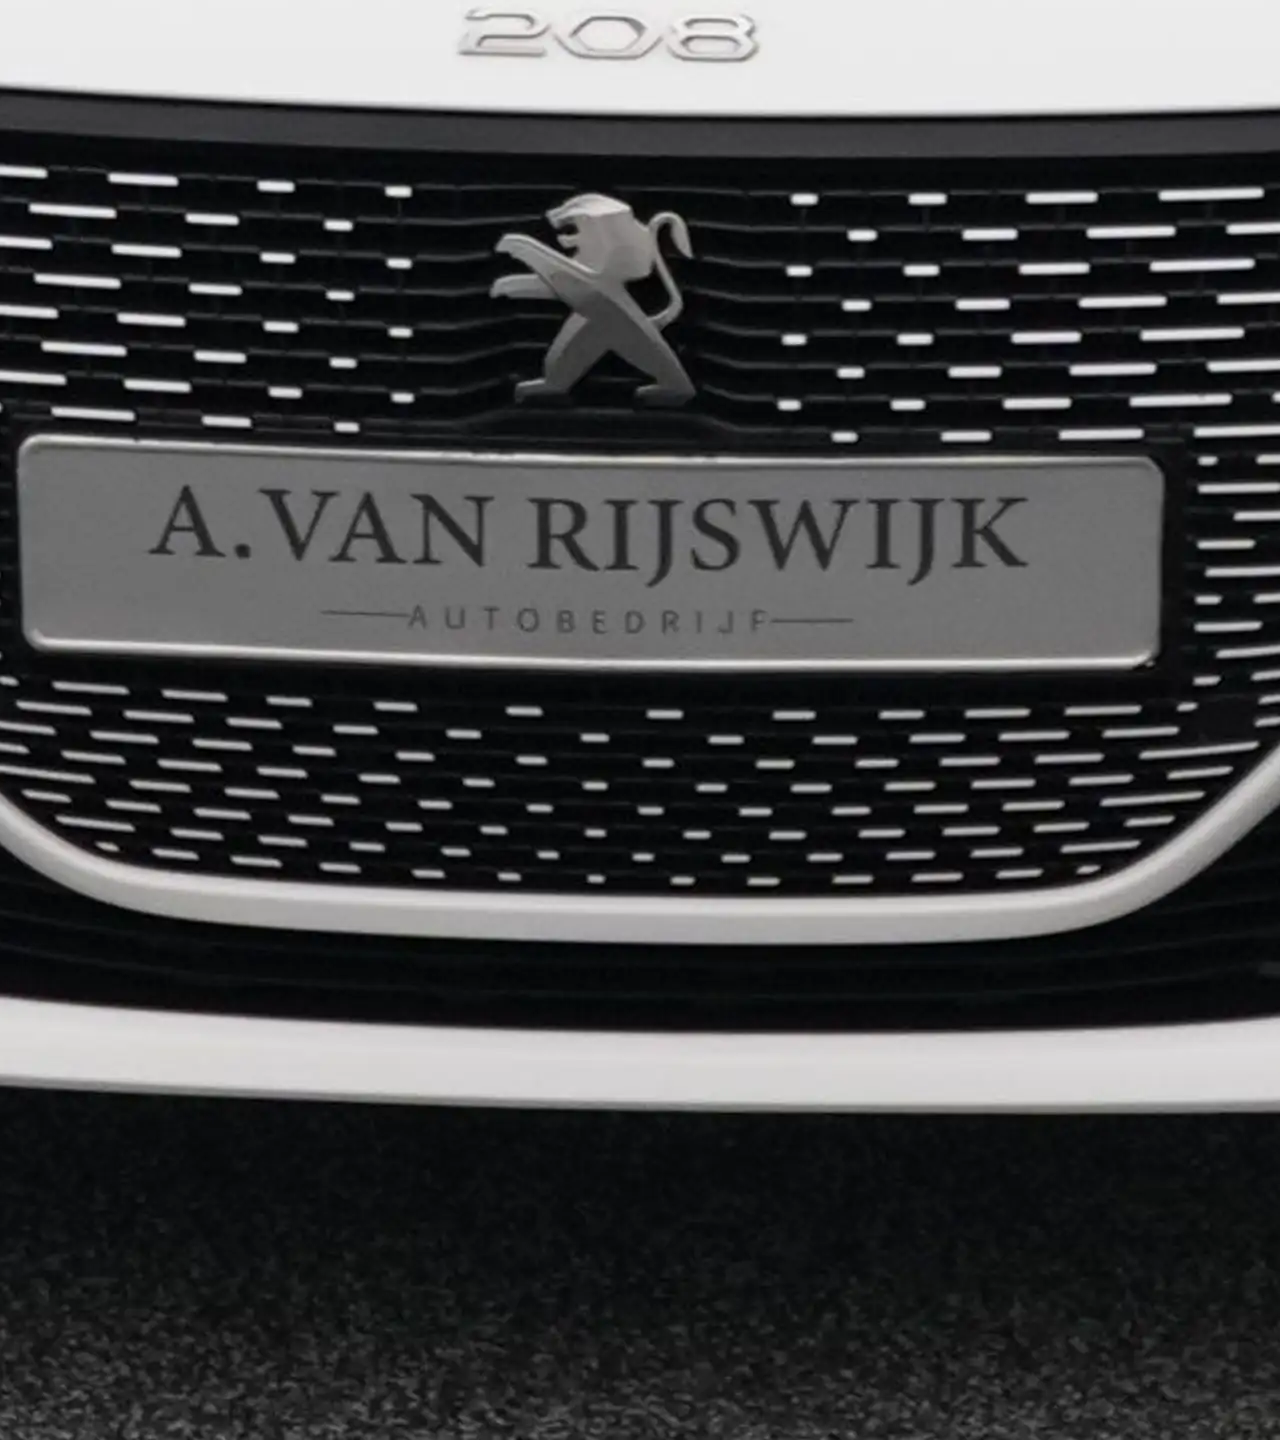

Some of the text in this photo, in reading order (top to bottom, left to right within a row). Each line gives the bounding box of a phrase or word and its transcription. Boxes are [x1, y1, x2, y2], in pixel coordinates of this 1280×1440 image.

[457, 5, 761, 63] 208
[527, 496, 1030, 588] RIJSWIJK
[408, 604, 772, 635] AUTOBEDRIJF
